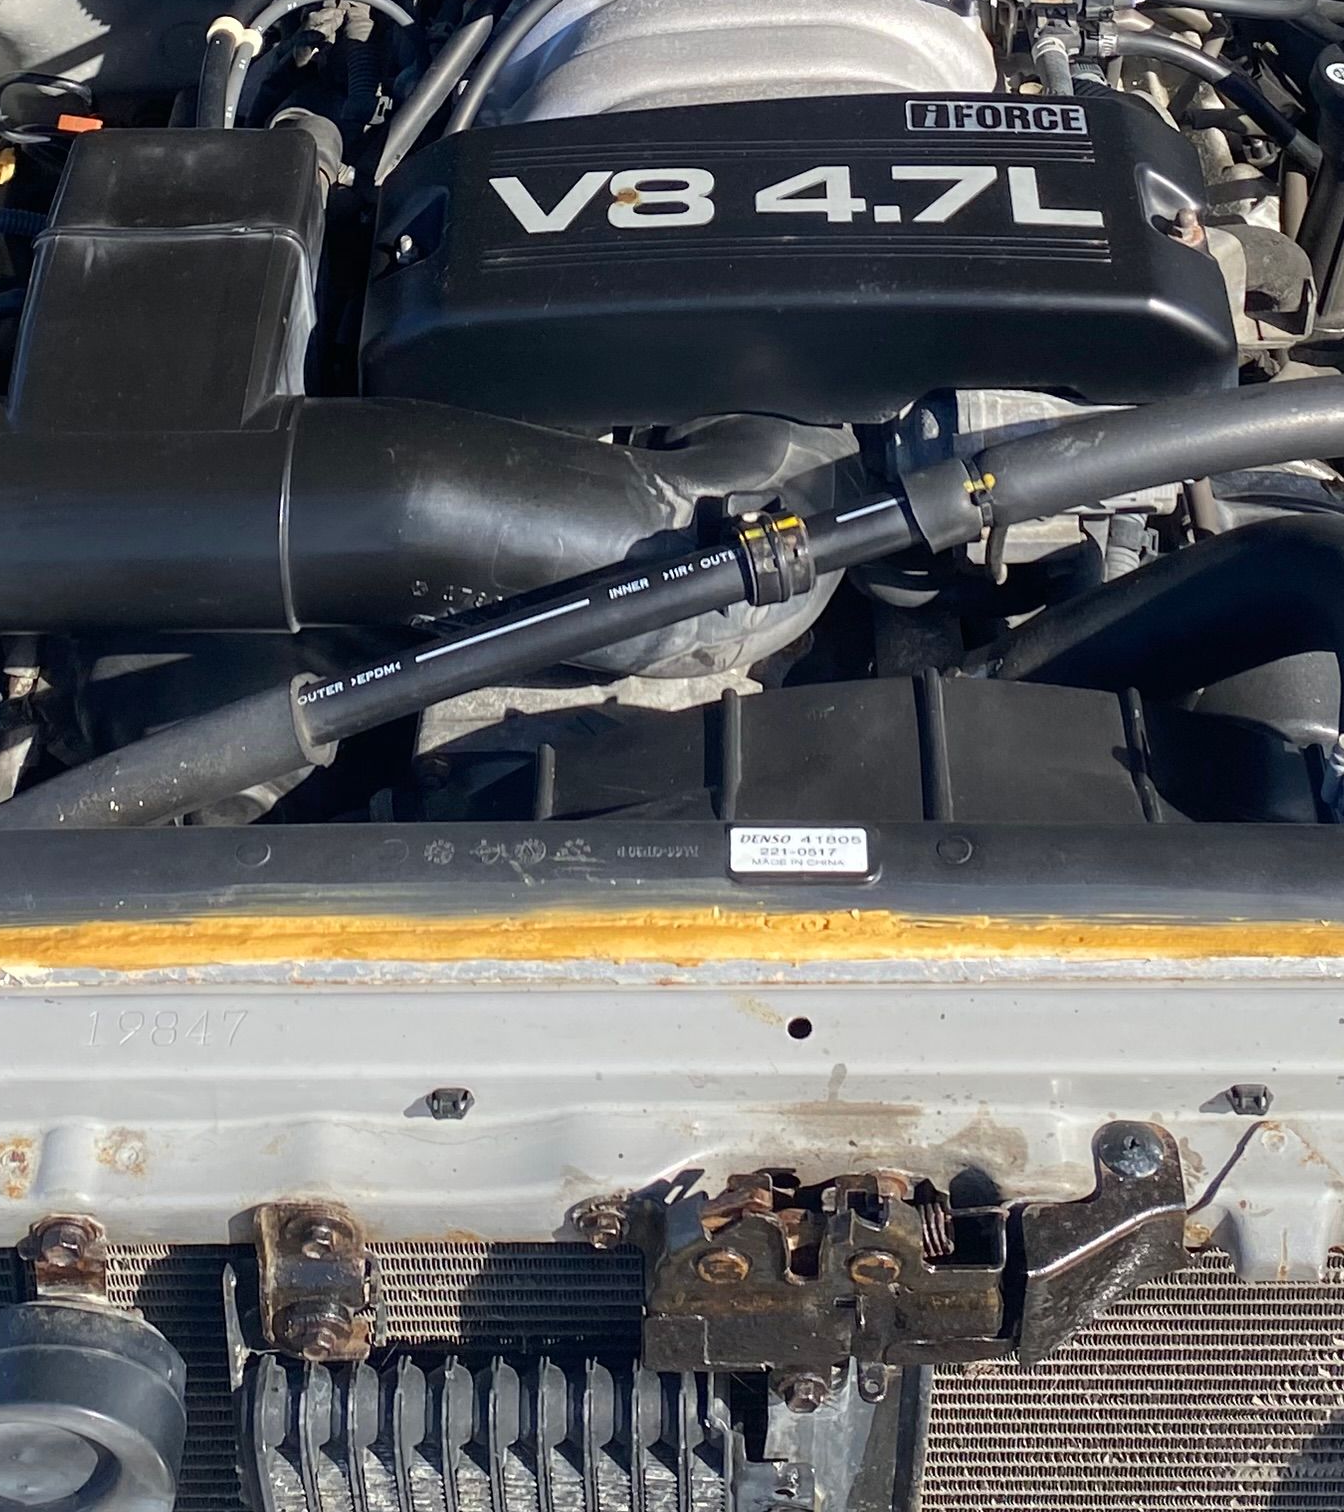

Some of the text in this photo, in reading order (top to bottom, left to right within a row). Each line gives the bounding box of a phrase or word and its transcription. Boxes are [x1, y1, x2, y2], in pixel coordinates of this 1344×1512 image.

[489, 165, 1103, 234] V8 4.7L
[608, 577, 650, 600] INNER
[700, 549, 736, 569] OUTE
[297, 681, 344, 705] OUTER
[740, 834, 791, 844] DENSO
[85, 1009, 249, 1048] 19847
